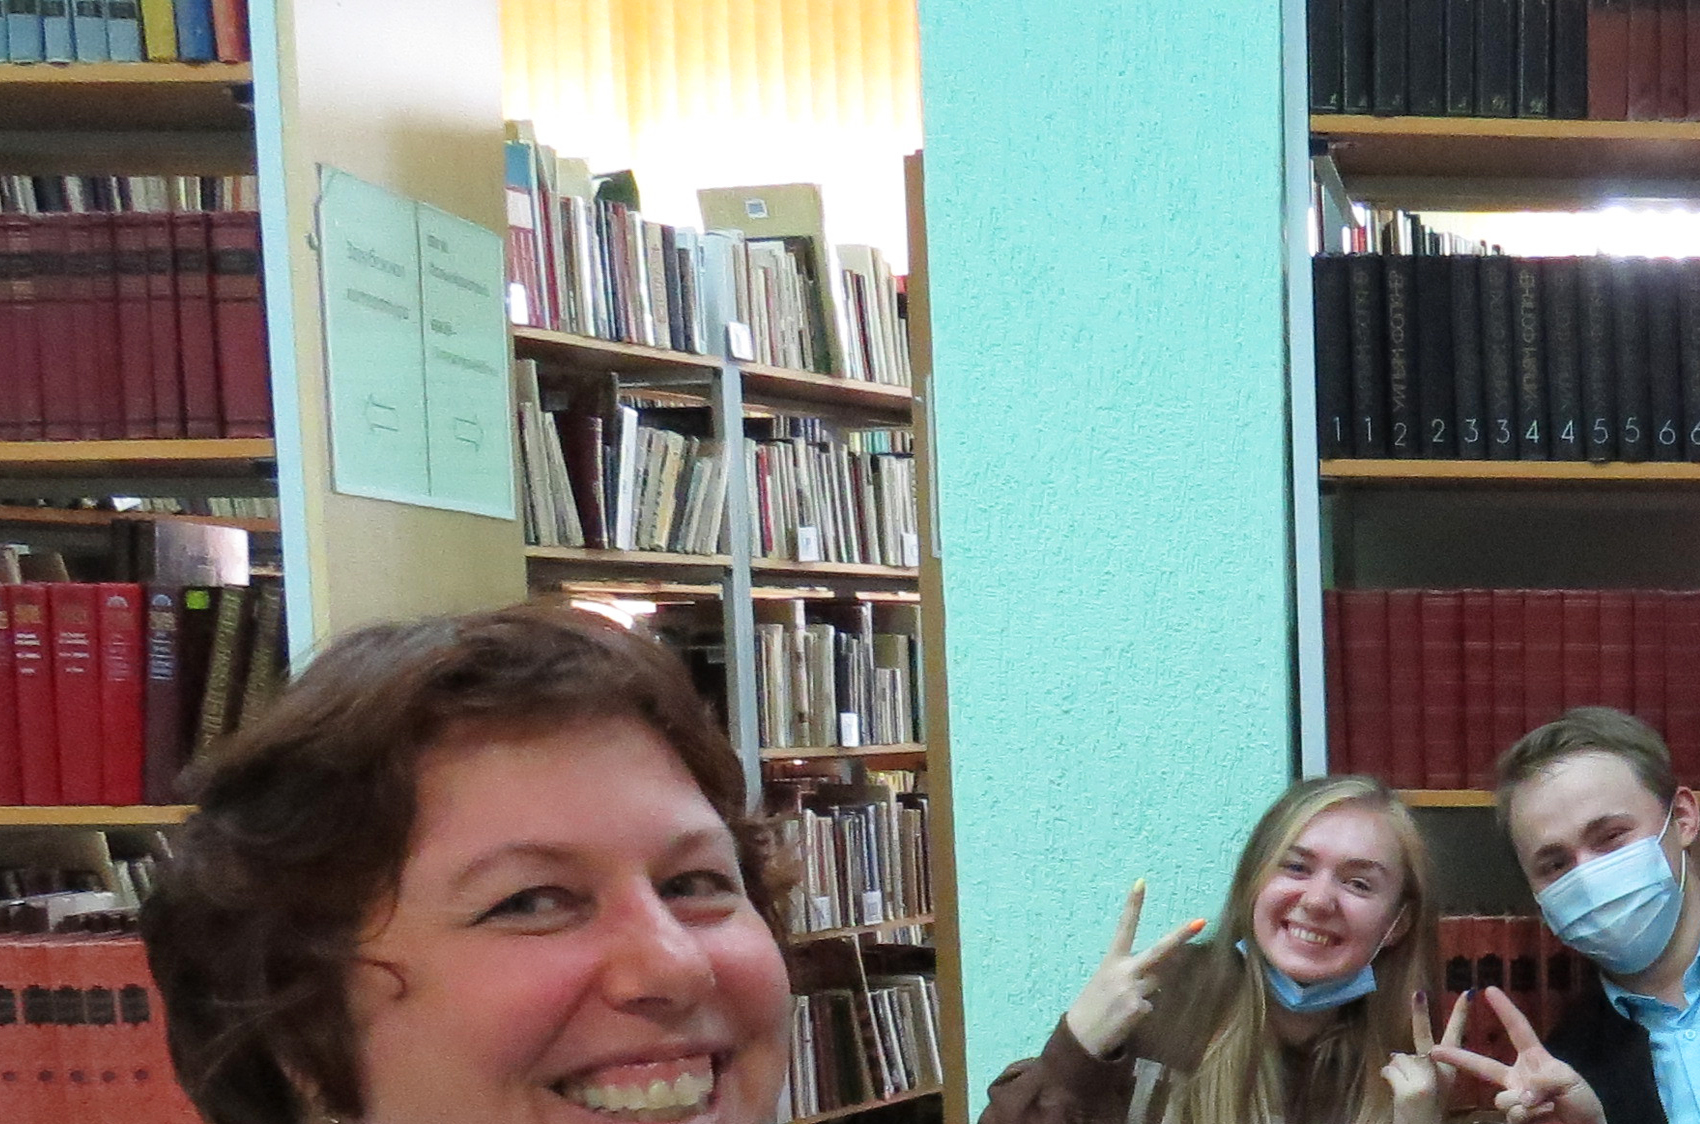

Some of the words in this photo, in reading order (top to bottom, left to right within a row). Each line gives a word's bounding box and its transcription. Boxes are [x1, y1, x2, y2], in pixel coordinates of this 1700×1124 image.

[1333, 416, 1341, 442] 1
[1365, 416, 1372, 442] 1
[1394, 422, 1407, 447] 2
[1431, 418, 1445, 443] 2
[1464, 418, 1479, 443] 3
[1496, 419, 1510, 444] 3
[1525, 418, 1540, 444] 4
[1561, 418, 1575, 444] 4
[1593, 418, 1609, 444] 5
[1624, 416, 1640, 443] 5
[1659, 419, 1676, 445] 6
